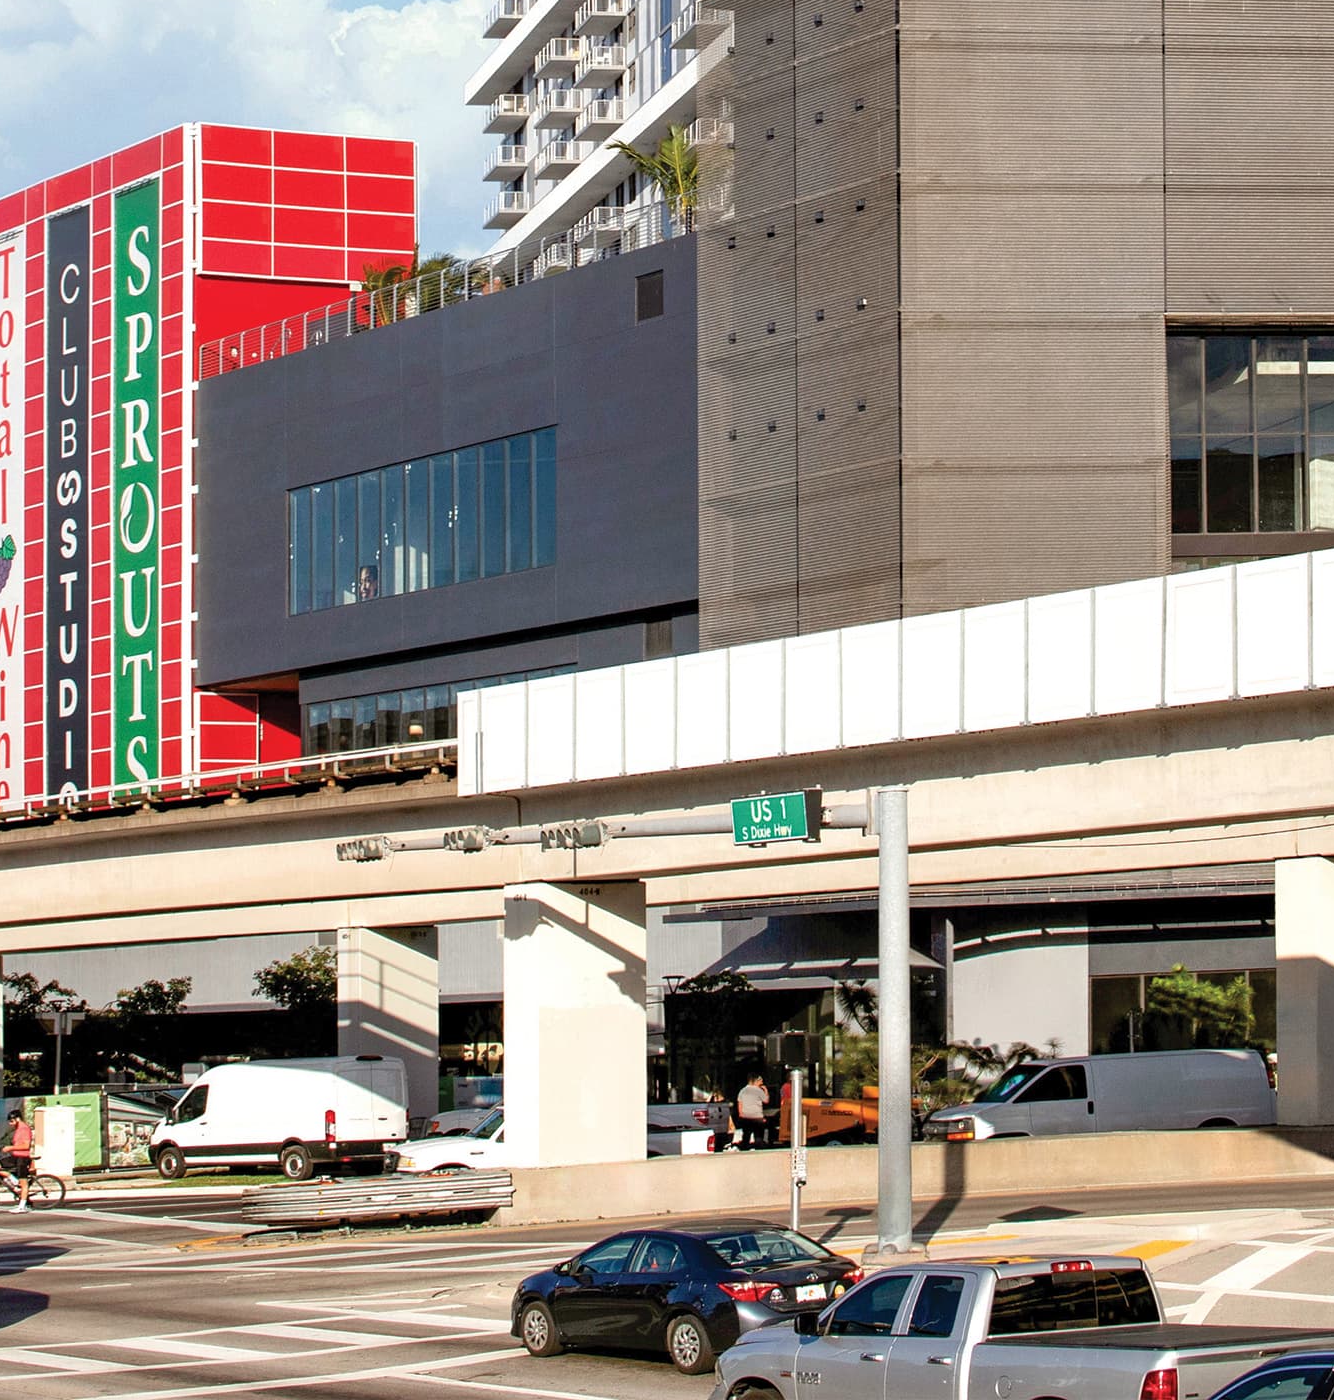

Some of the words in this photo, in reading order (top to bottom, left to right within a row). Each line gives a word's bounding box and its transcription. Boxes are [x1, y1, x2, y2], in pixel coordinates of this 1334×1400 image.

[59, 262, 80, 458] CLUB
[119, 224, 155, 796] SPROUTS
[742, 826, 749, 840] S
[750, 824, 772, 839] Dixie
[750, 799, 773, 823] US
[780, 797, 787, 820] 1
